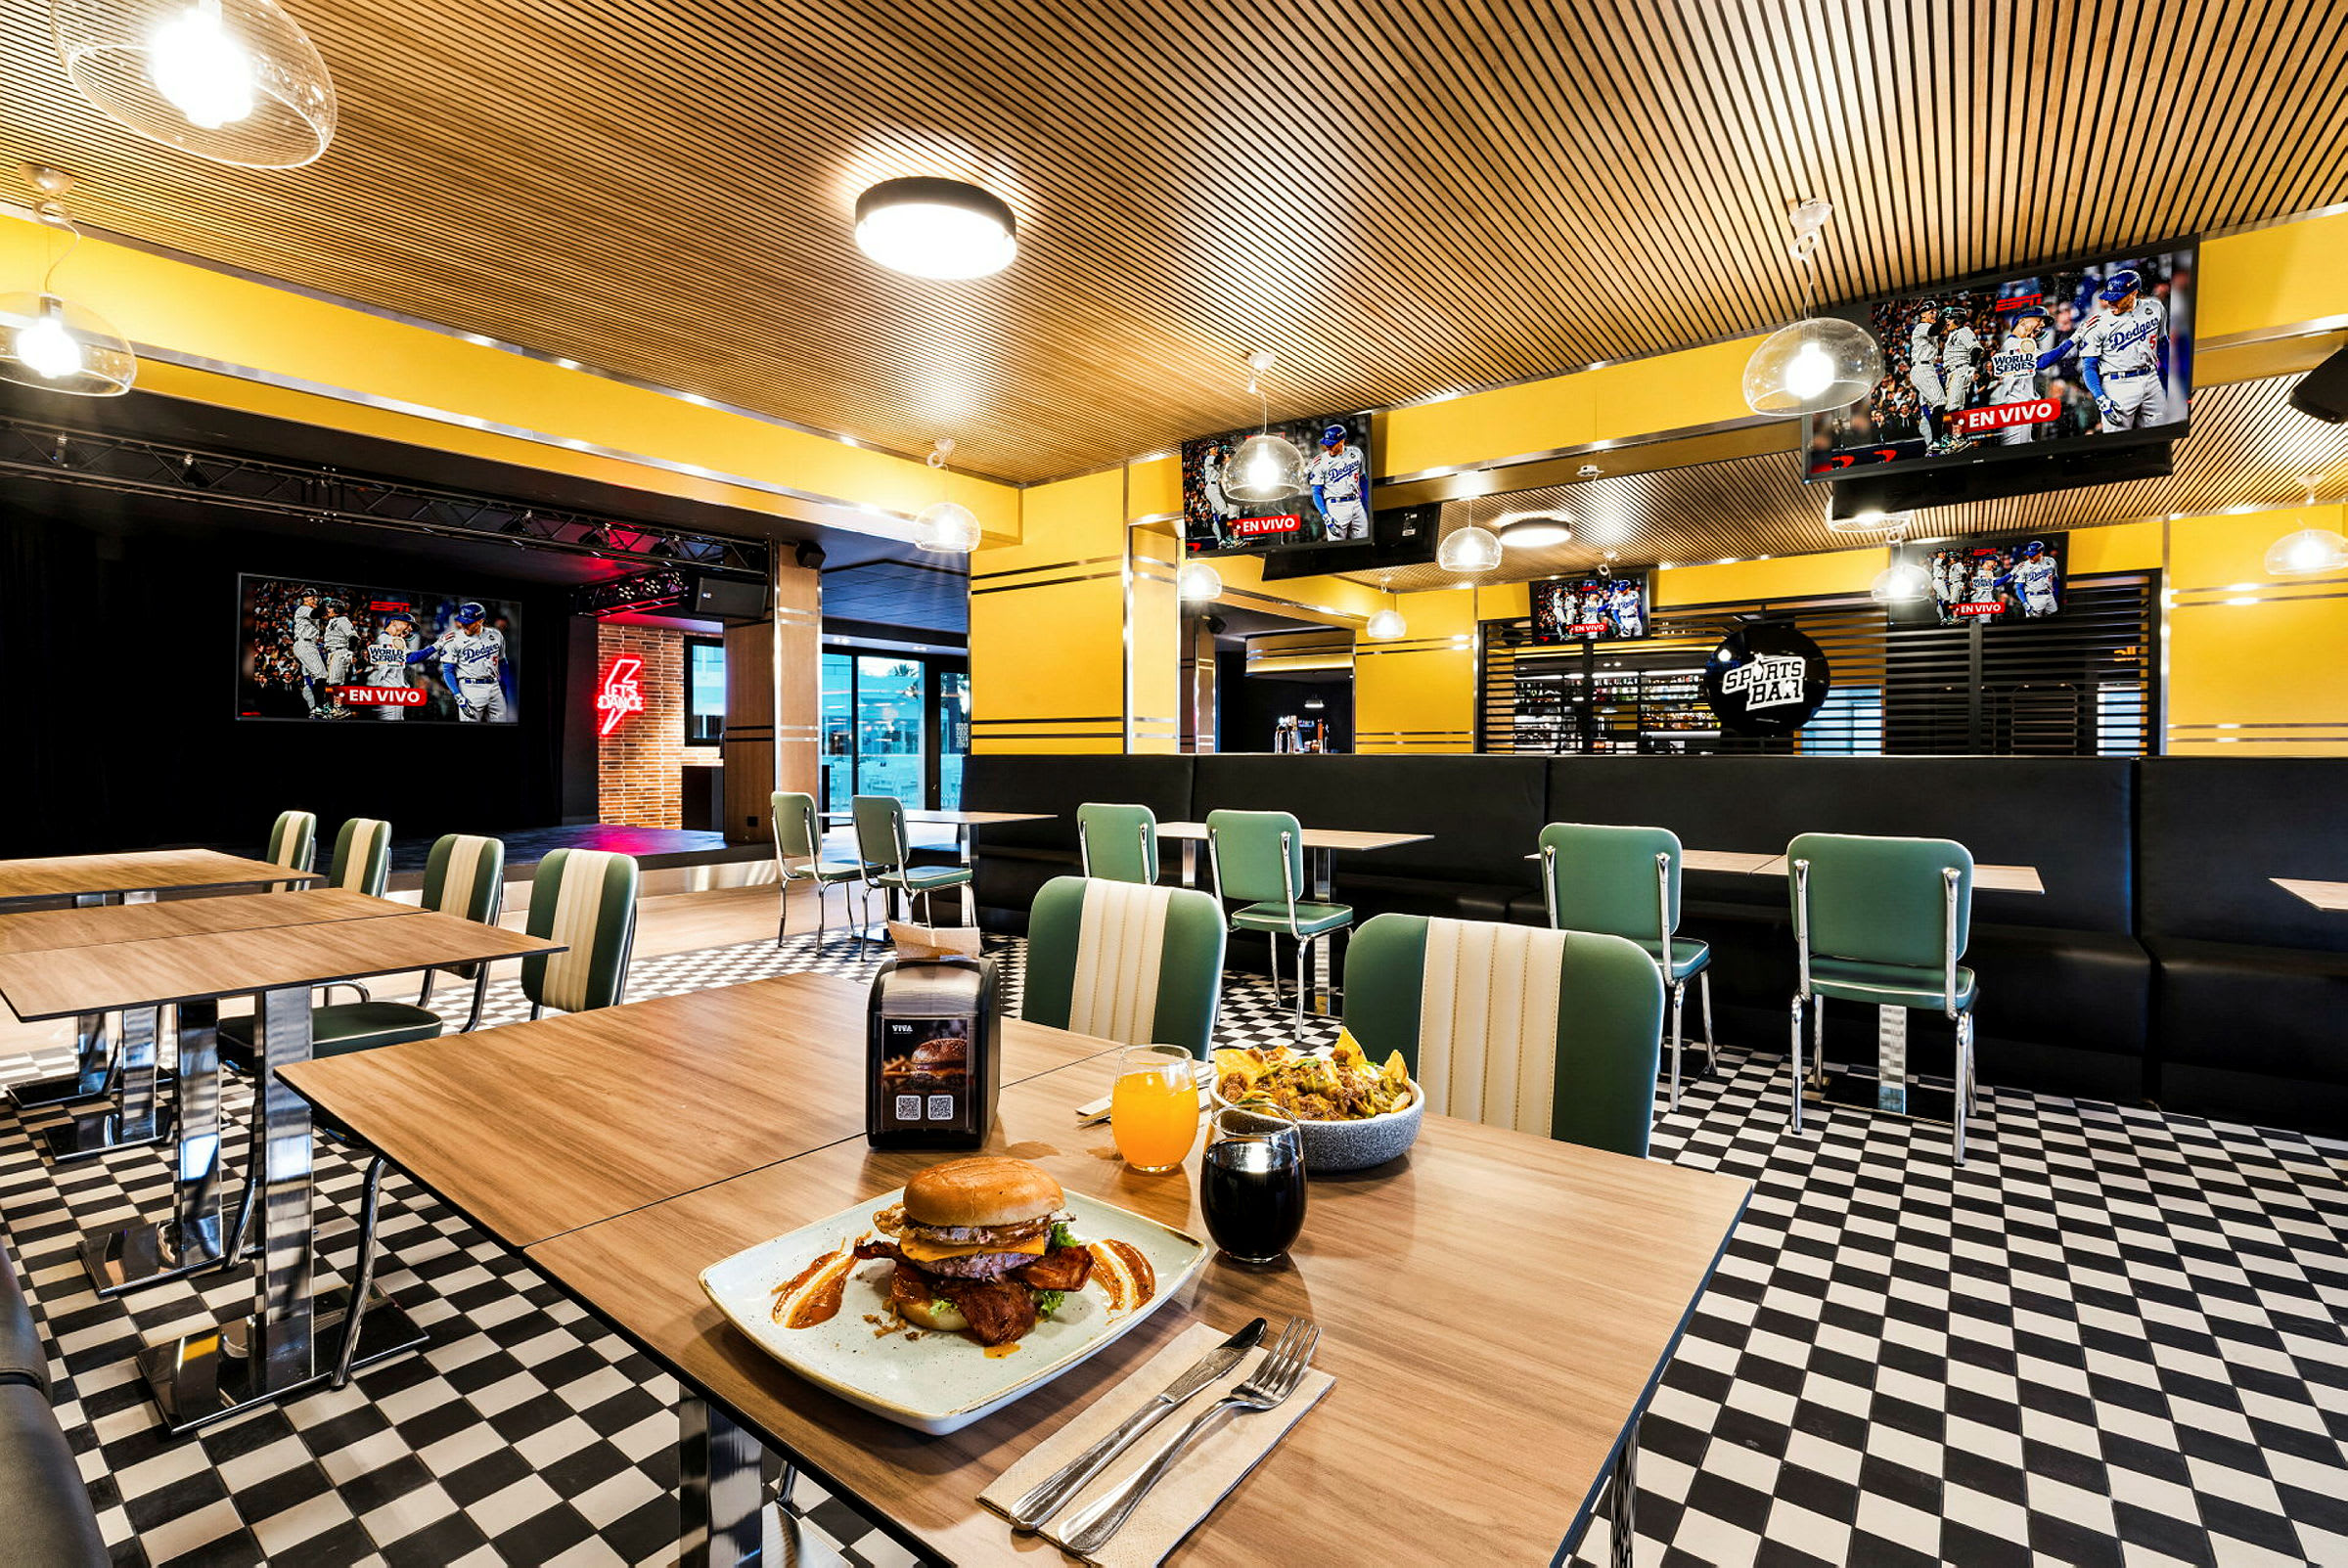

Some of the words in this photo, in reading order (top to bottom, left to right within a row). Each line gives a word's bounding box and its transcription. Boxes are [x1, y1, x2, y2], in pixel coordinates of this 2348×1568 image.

[1996, 292, 2042, 312] ESPN
[2110, 316, 2160, 352] Dodgers
[2148, 335, 2157, 350] 5
[1994, 353, 2034, 366] WORLD
[1995, 361, 2035, 376] SERIES
[1968, 410, 1996, 428] EN
[1998, 402, 2053, 424] VIVO
[1354, 473, 1360, 483] 5
[1242, 520, 1260, 533] EN
[1260, 517, 1295, 530] VIVO
[1961, 605, 1975, 613] EN
[1976, 604, 2002, 612] VIVO
[370, 647, 403, 656] WORLD
[491, 655, 499, 666] 5
[1725, 660, 1803, 691] SPORTS
[348, 689, 373, 702] EN
[376, 690, 421, 702] VIVO
[1749, 679, 1802, 705] BAR
[597, 694, 644, 711] DANCE
